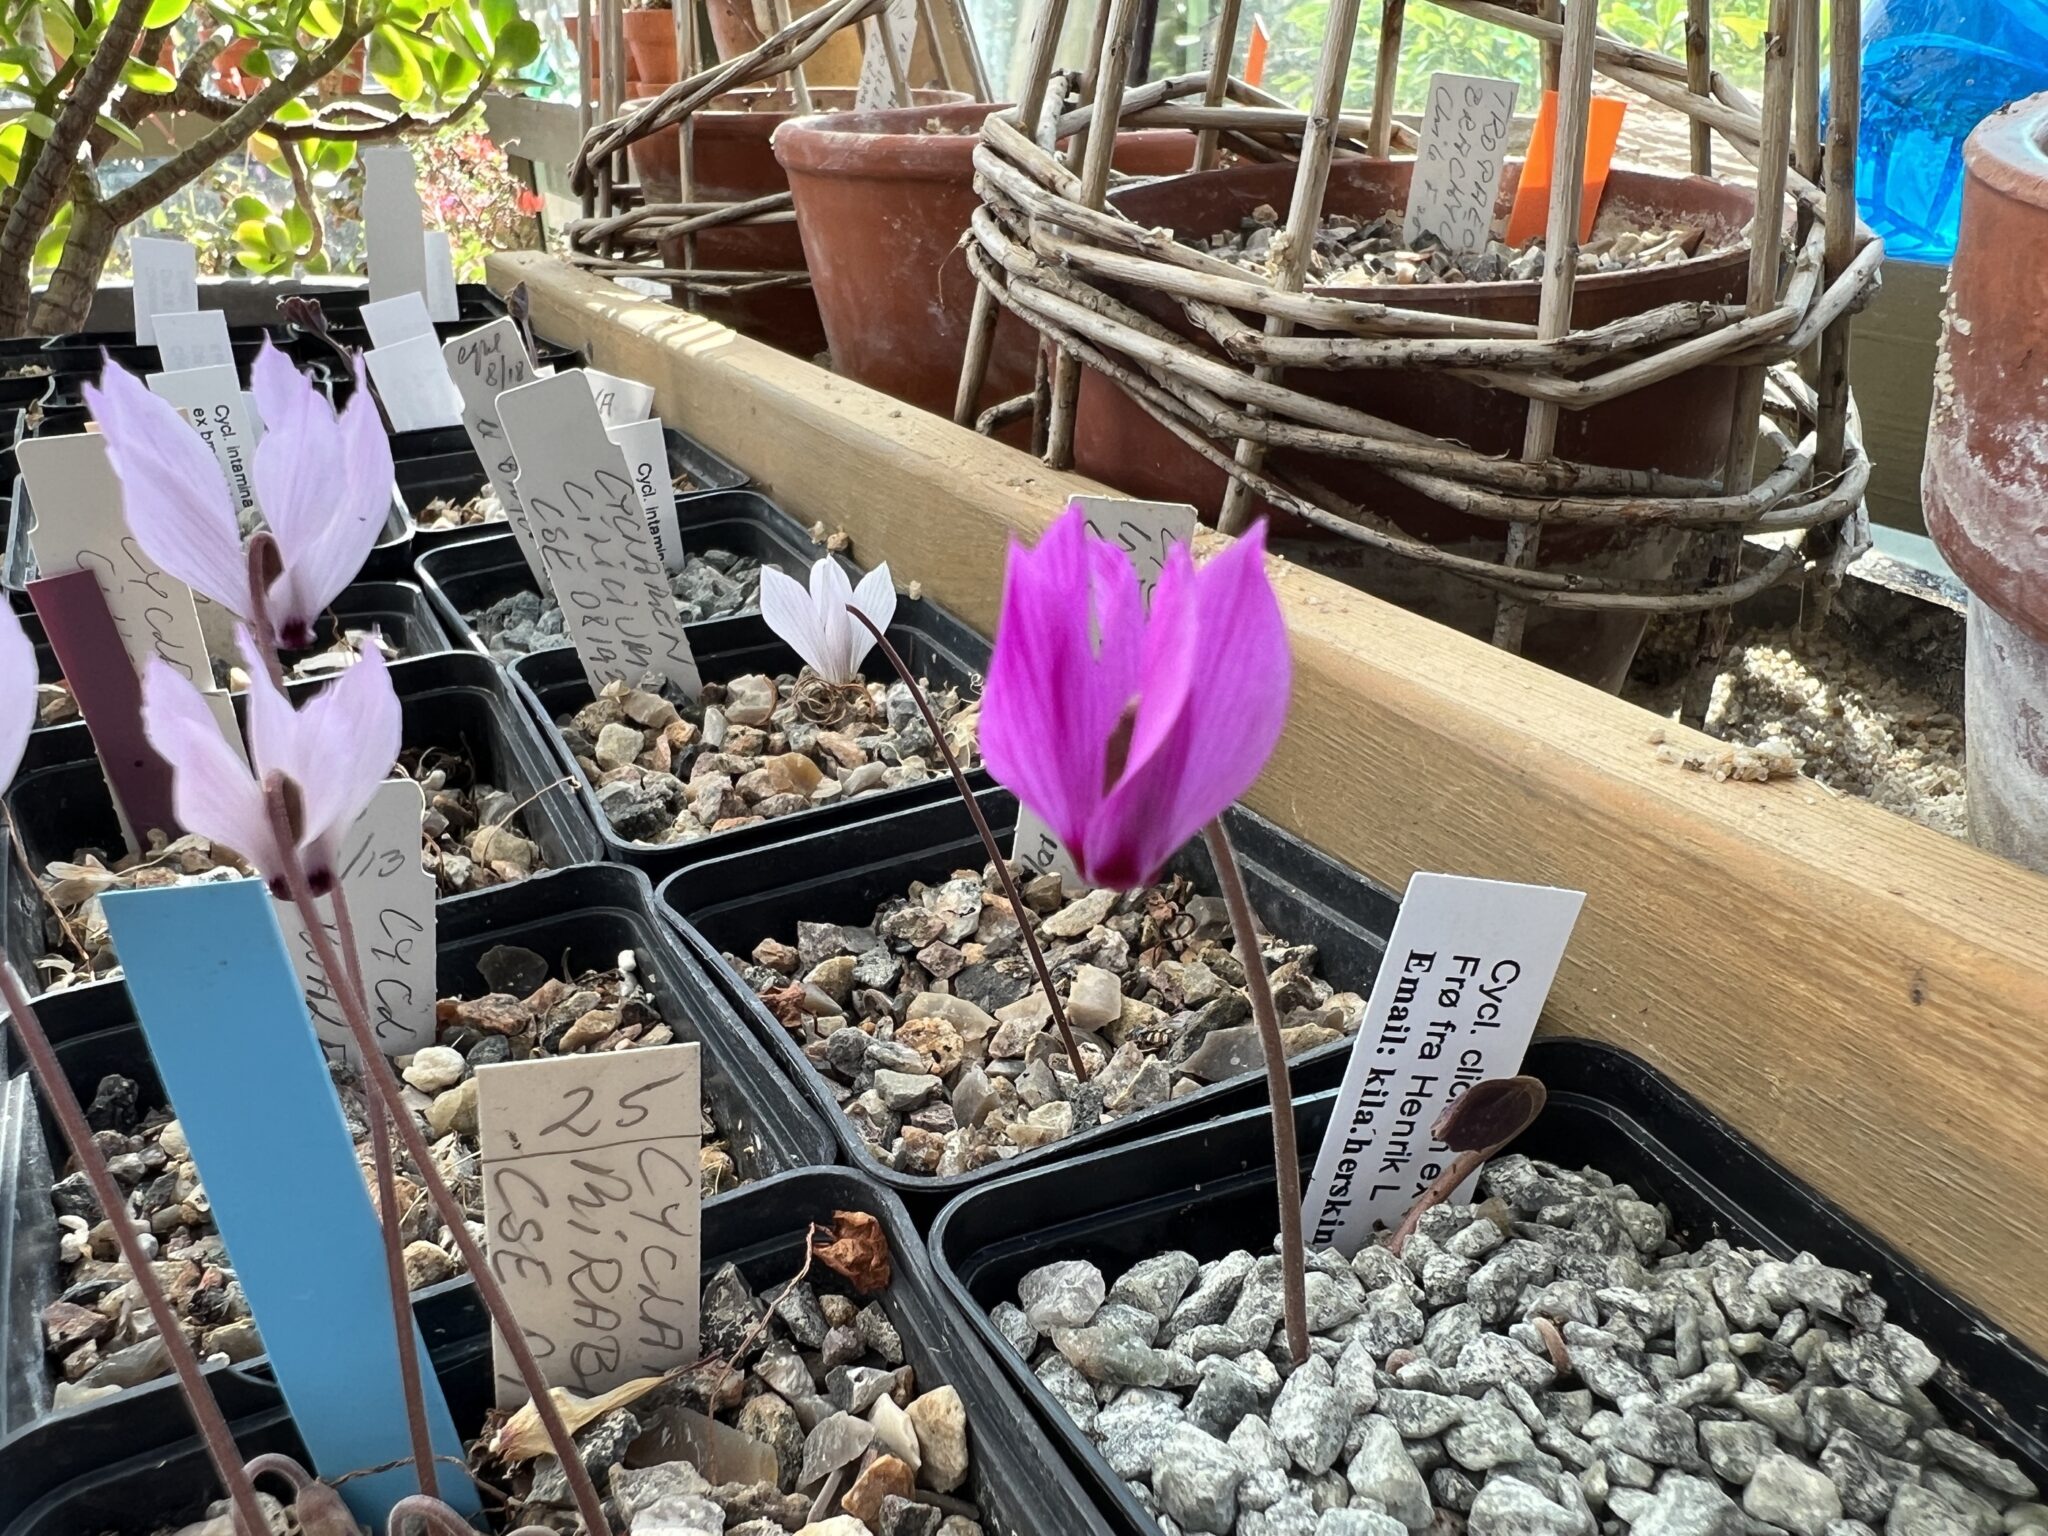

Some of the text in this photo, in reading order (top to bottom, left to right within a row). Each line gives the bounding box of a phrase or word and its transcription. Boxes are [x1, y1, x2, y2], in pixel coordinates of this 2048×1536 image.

[192, 407, 207, 427] ex
[214, 404, 237, 442] Cycl.
[635, 462, 667, 565] Cycl. intamin
[594, 469, 694, 665] CYCLAMEN
[1376, 949, 1437, 1055] Email:
[1438, 955, 1480, 1008] Frø
[1471, 959, 1521, 1035] Cycl.
[1418, 1020, 1456, 1060] fra
[1379, 1074, 1438, 1174] Henrik
[493, 1168, 553, 1286] CSE
[630, 1147, 694, 1374] CYCLA
[567, 1160, 633, 1398] MiRAB
